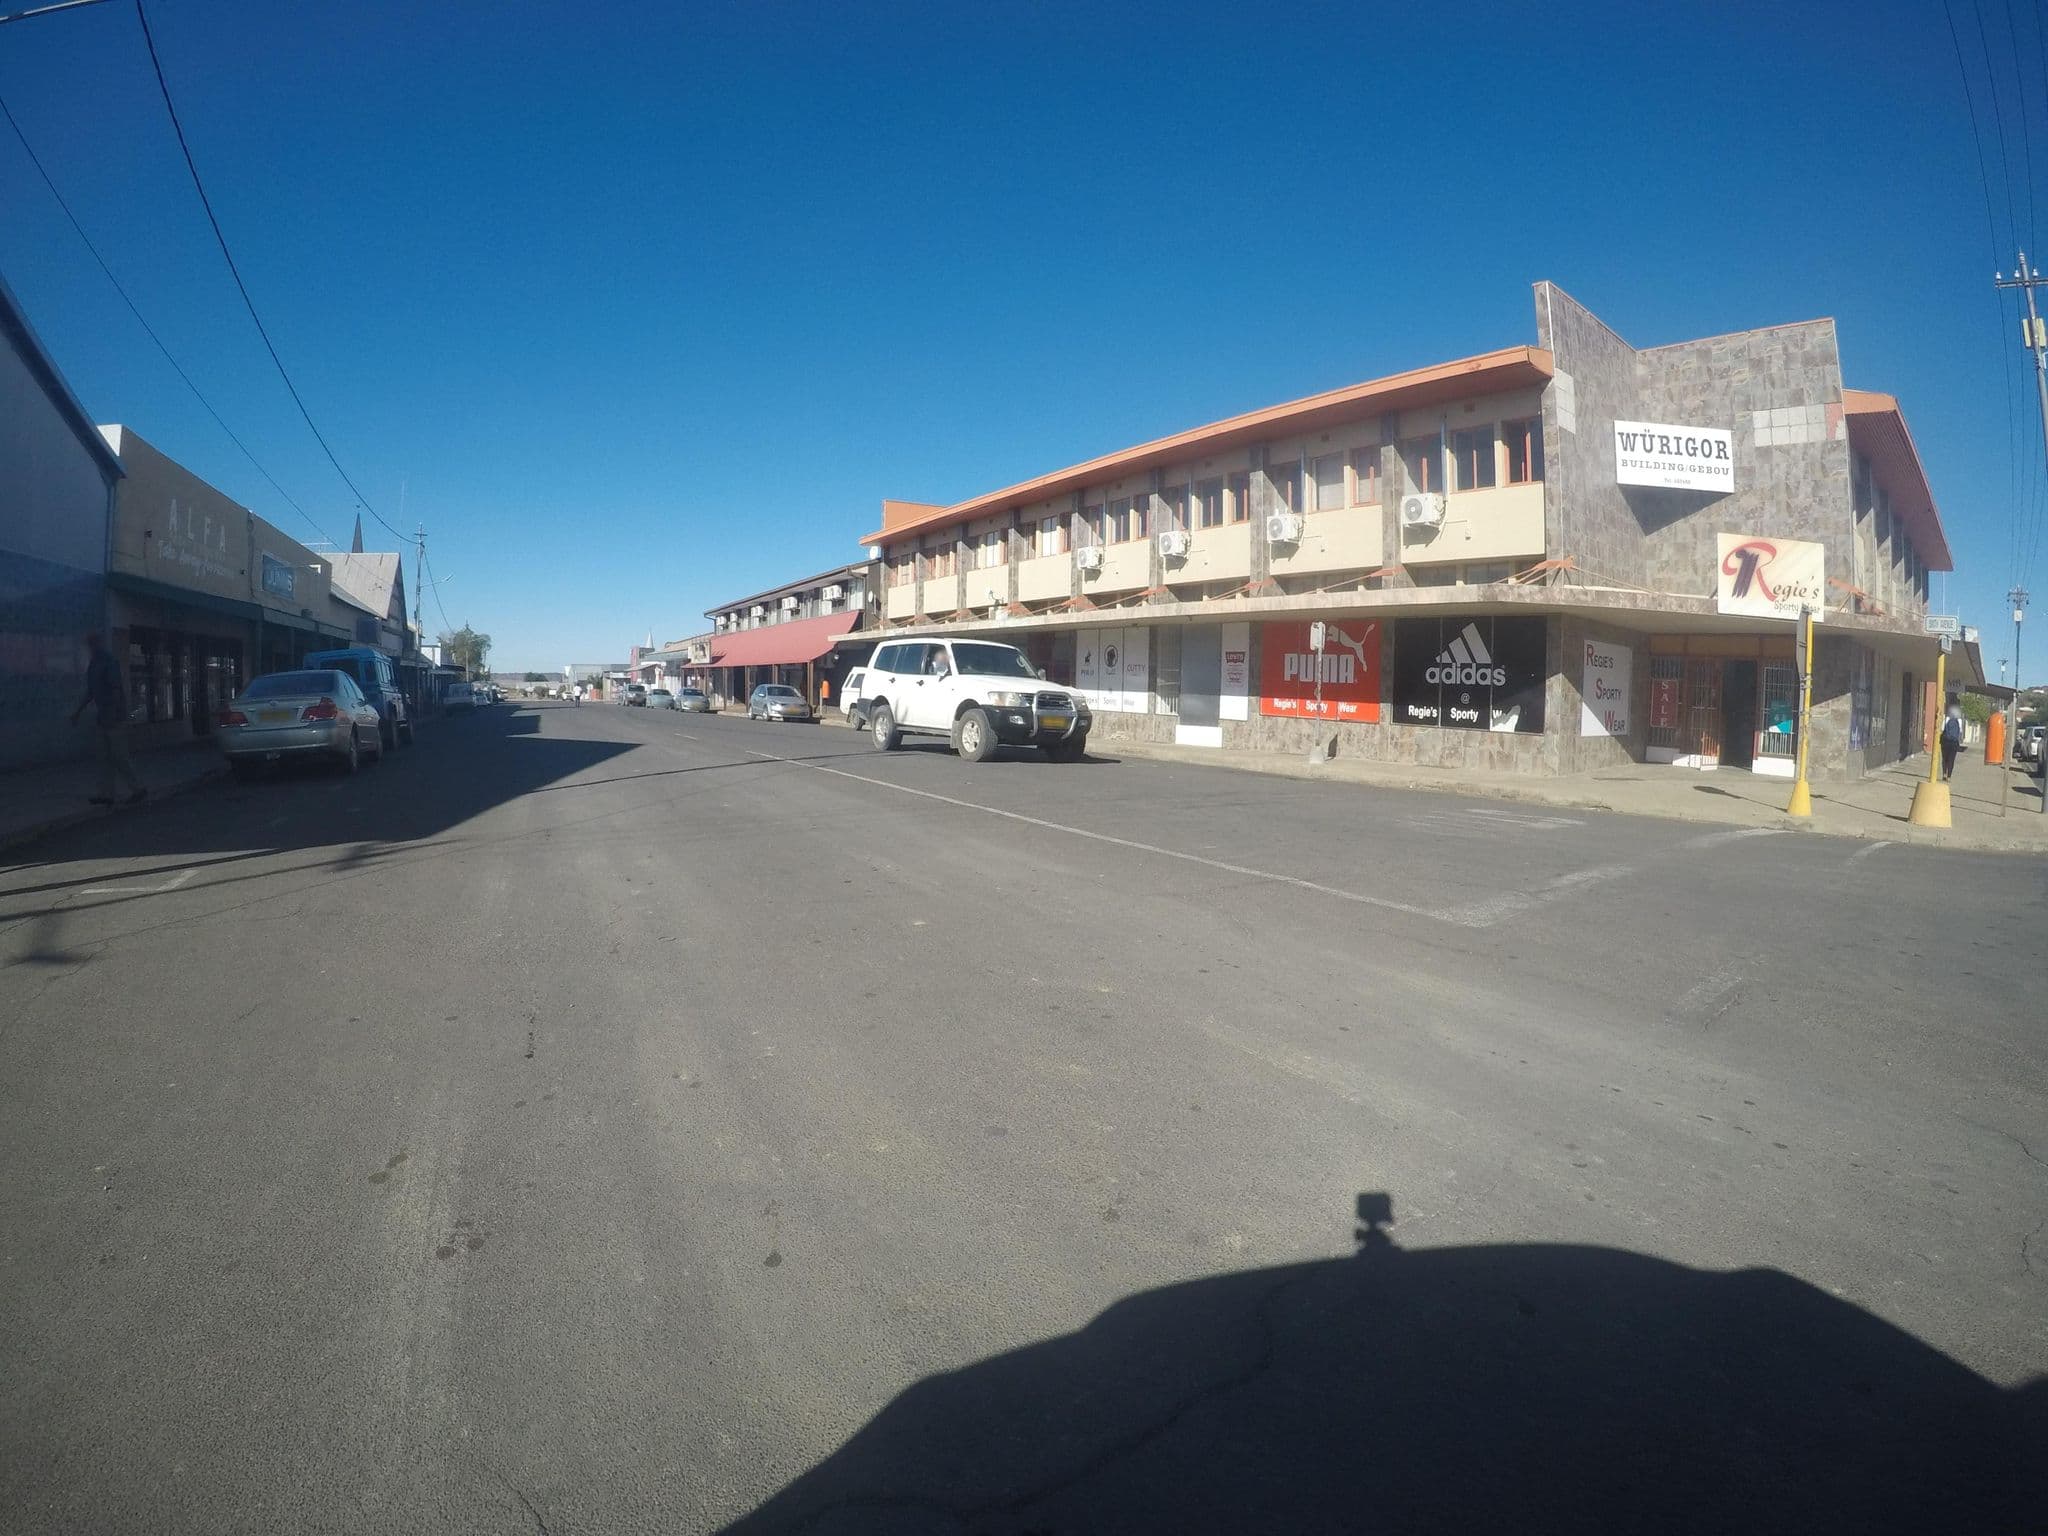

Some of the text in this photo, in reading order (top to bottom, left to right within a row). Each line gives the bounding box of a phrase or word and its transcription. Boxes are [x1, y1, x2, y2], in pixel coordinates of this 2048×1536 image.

[1617, 429, 1730, 460] WÜRIGOR
[168, 499, 226, 553] ALFA
[1722, 541, 1820, 602] Regie's
[1774, 600, 1799, 614] Sporty
[1284, 653, 1355, 684] PUMA
[1425, 662, 1506, 687] adidas
[1595, 678, 1622, 701] SPORTY
[1273, 698, 1297, 710] Regie's
[1338, 702, 1357, 713] Wear
[1408, 705, 1438, 719] Regie's
[1450, 707, 1479, 723] Sporty
[1660, 681, 1669, 727] SALE
[1604, 710, 1626, 732] WEAR
